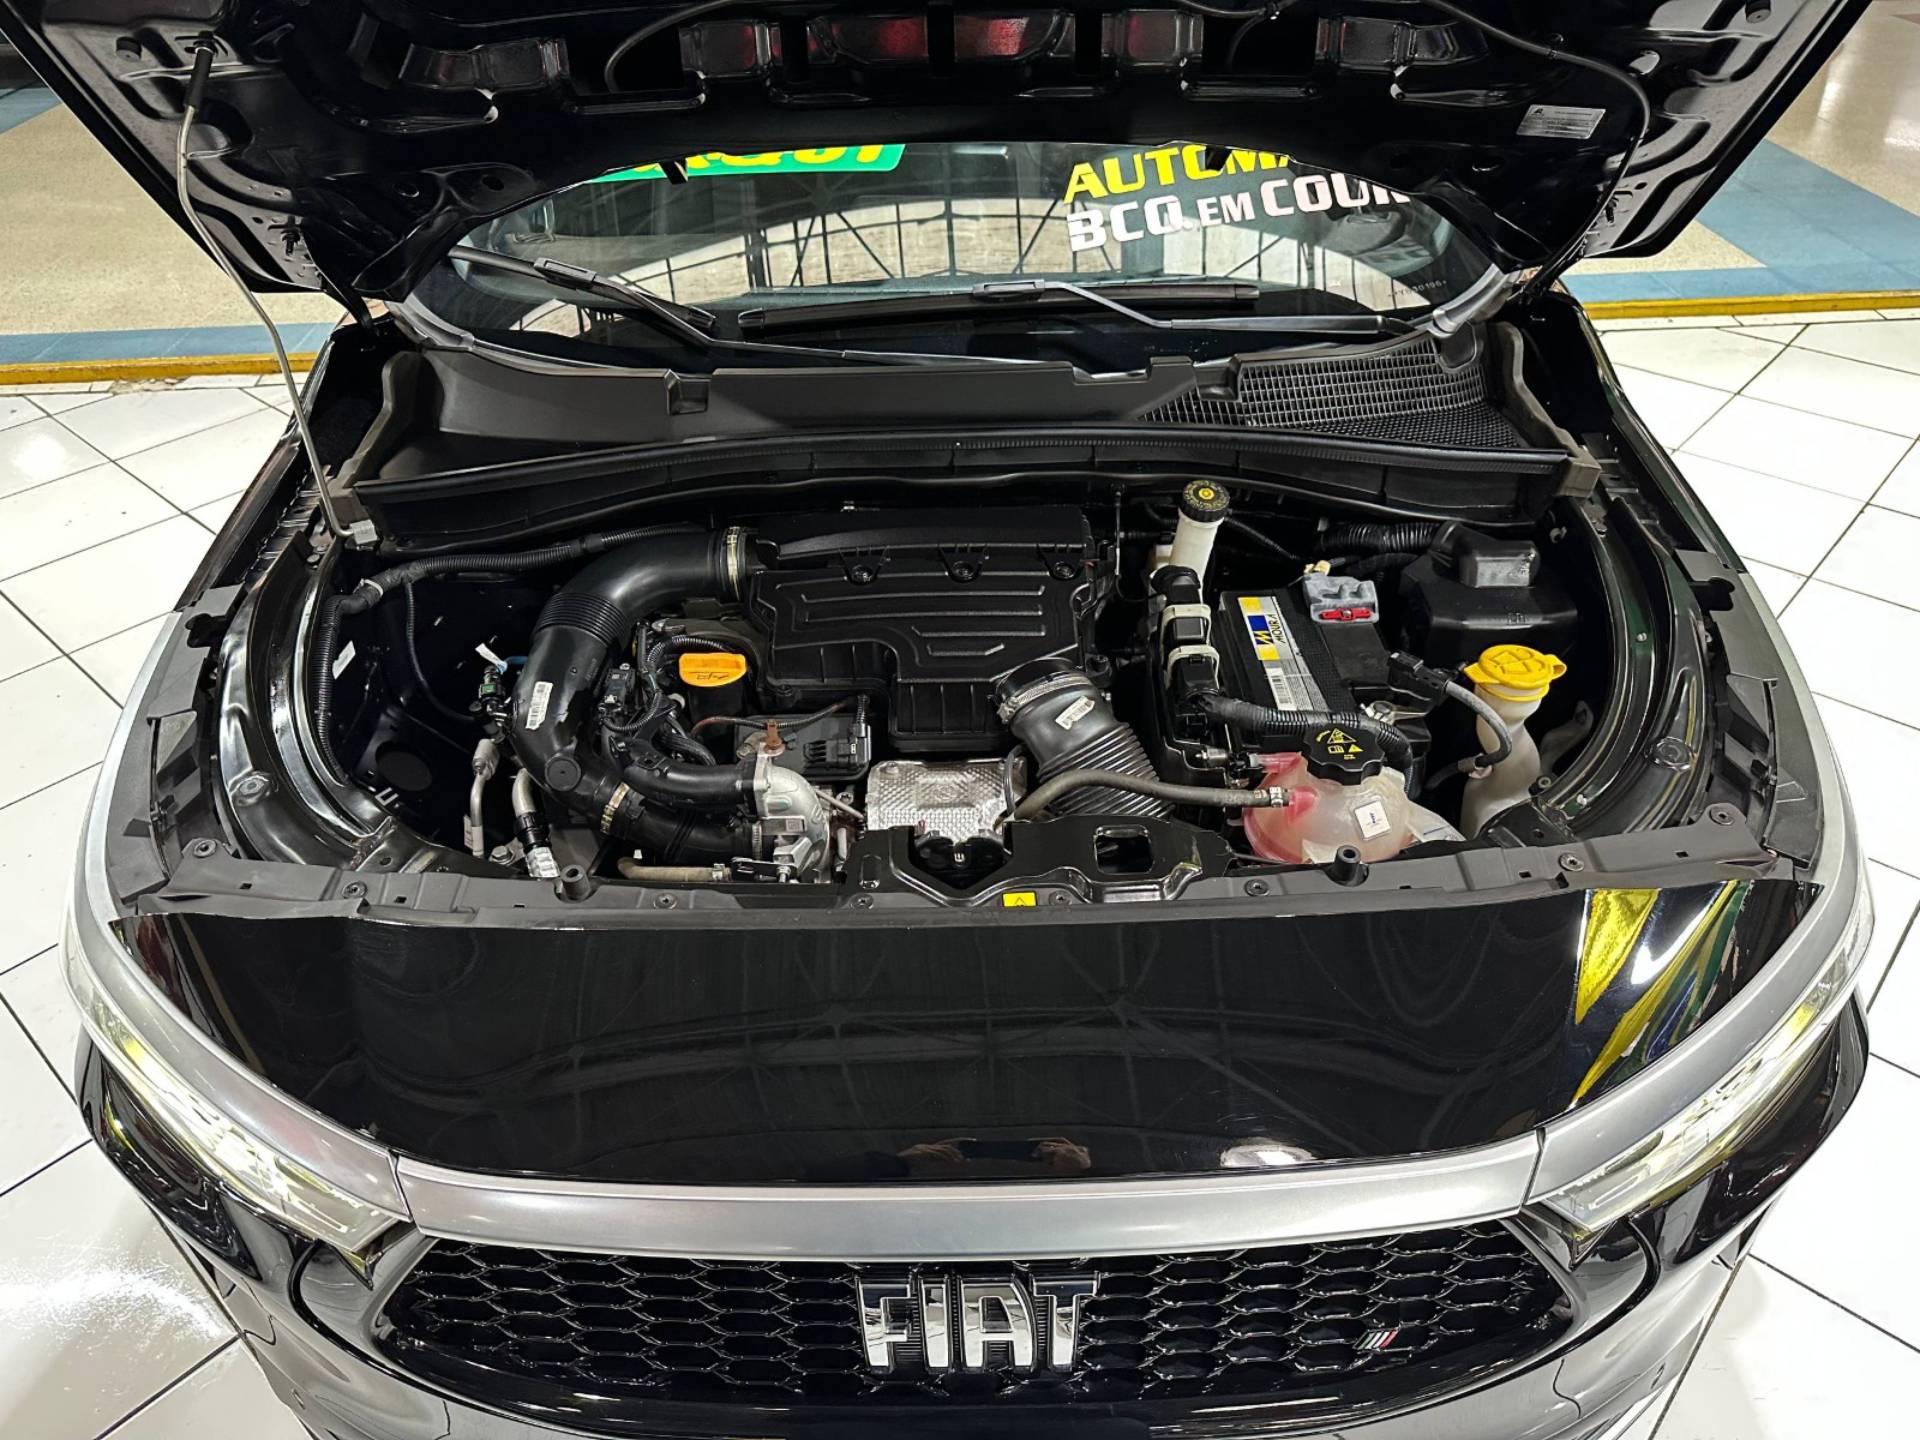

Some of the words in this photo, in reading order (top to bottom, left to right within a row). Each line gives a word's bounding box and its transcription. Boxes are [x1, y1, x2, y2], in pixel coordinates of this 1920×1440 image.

[1064, 144, 1290, 204] AUTOM
[1197, 192, 1255, 227] EM
[1267, 614, 1286, 644] MOURA
[857, 1280, 1098, 1369] FIAT
